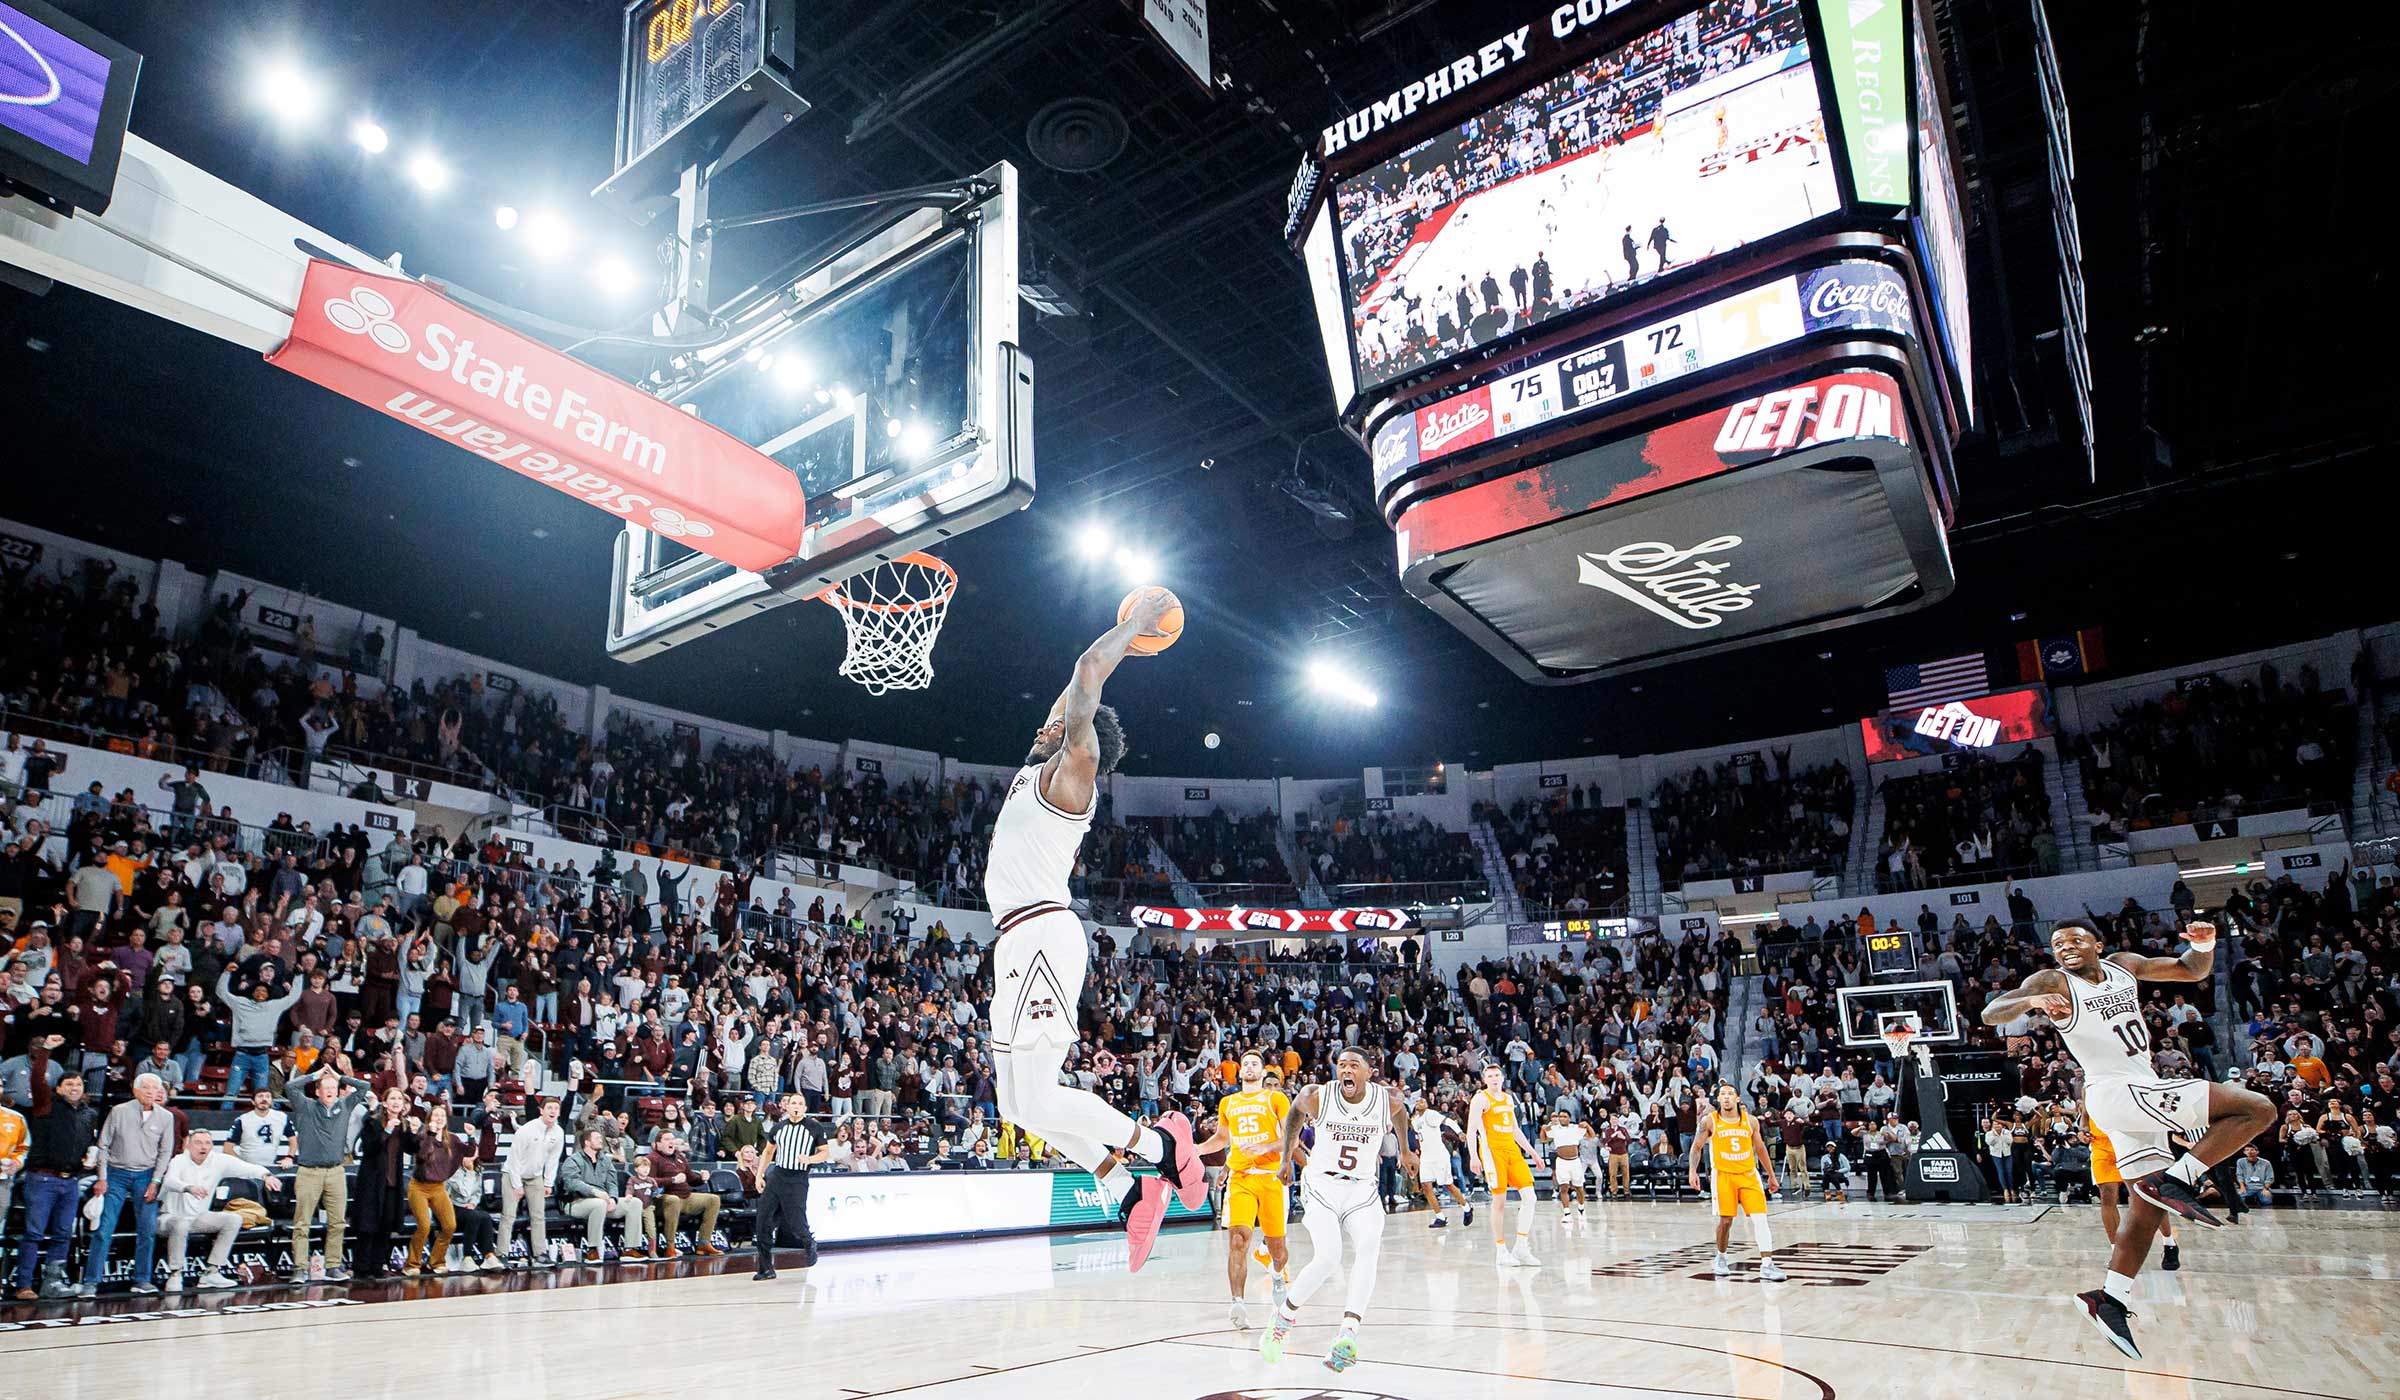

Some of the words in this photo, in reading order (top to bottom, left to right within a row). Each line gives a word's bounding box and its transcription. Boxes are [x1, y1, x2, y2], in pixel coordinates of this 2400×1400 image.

[1322, 25, 1530, 157] HUMPHREY
[1852, 38, 1894, 198] REGIONS
[1648, 324, 1684, 355] 72
[1685, 348, 1697, 363] 2
[1511, 373, 1542, 402] 75
[1572, 363, 1615, 397] 00.7
[1713, 386, 1819, 453] GET
[1815, 383, 1892, 441] ON
[1420, 402, 1490, 451] State
[1577, 535, 1762, 630] State
[1914, 706, 1961, 741] GET
[1957, 714, 2002, 749] ON
[405, 779, 419, 798] K
[1544, 776, 1564, 787] 235
[1370, 800, 1389, 810] 234
[372, 814, 390, 829] 116
[2209, 823, 2226, 838] A
[511, 840, 527, 854] 116
[2290, 856, 2313, 868] 102
[823, 863, 832, 878] L
[1742, 878, 1755, 892] N
[1956, 893, 1973, 905] 101
[1567, 920, 1591, 932] 00.5
[1685, 920, 1700, 930] 120
[1445, 932, 1460, 941] 120
[1871, 936, 1901, 951] 00.5
[2107, 1003, 2134, 1018] STATE
[2112, 1019, 2148, 1057] 10
[1237, 1115, 1260, 1134] 25
[1325, 1122, 1379, 1134] MISSISSIPPI
[257, 1124, 273, 1144] 4
[1731, 1137, 1741, 1152] 5
[1338, 1145, 1359, 1171] 5
[1923, 1166, 1955, 1174] BUREAU
[102, 1259, 136, 1277] LFA
[154, 1257, 208, 1274] AFA
